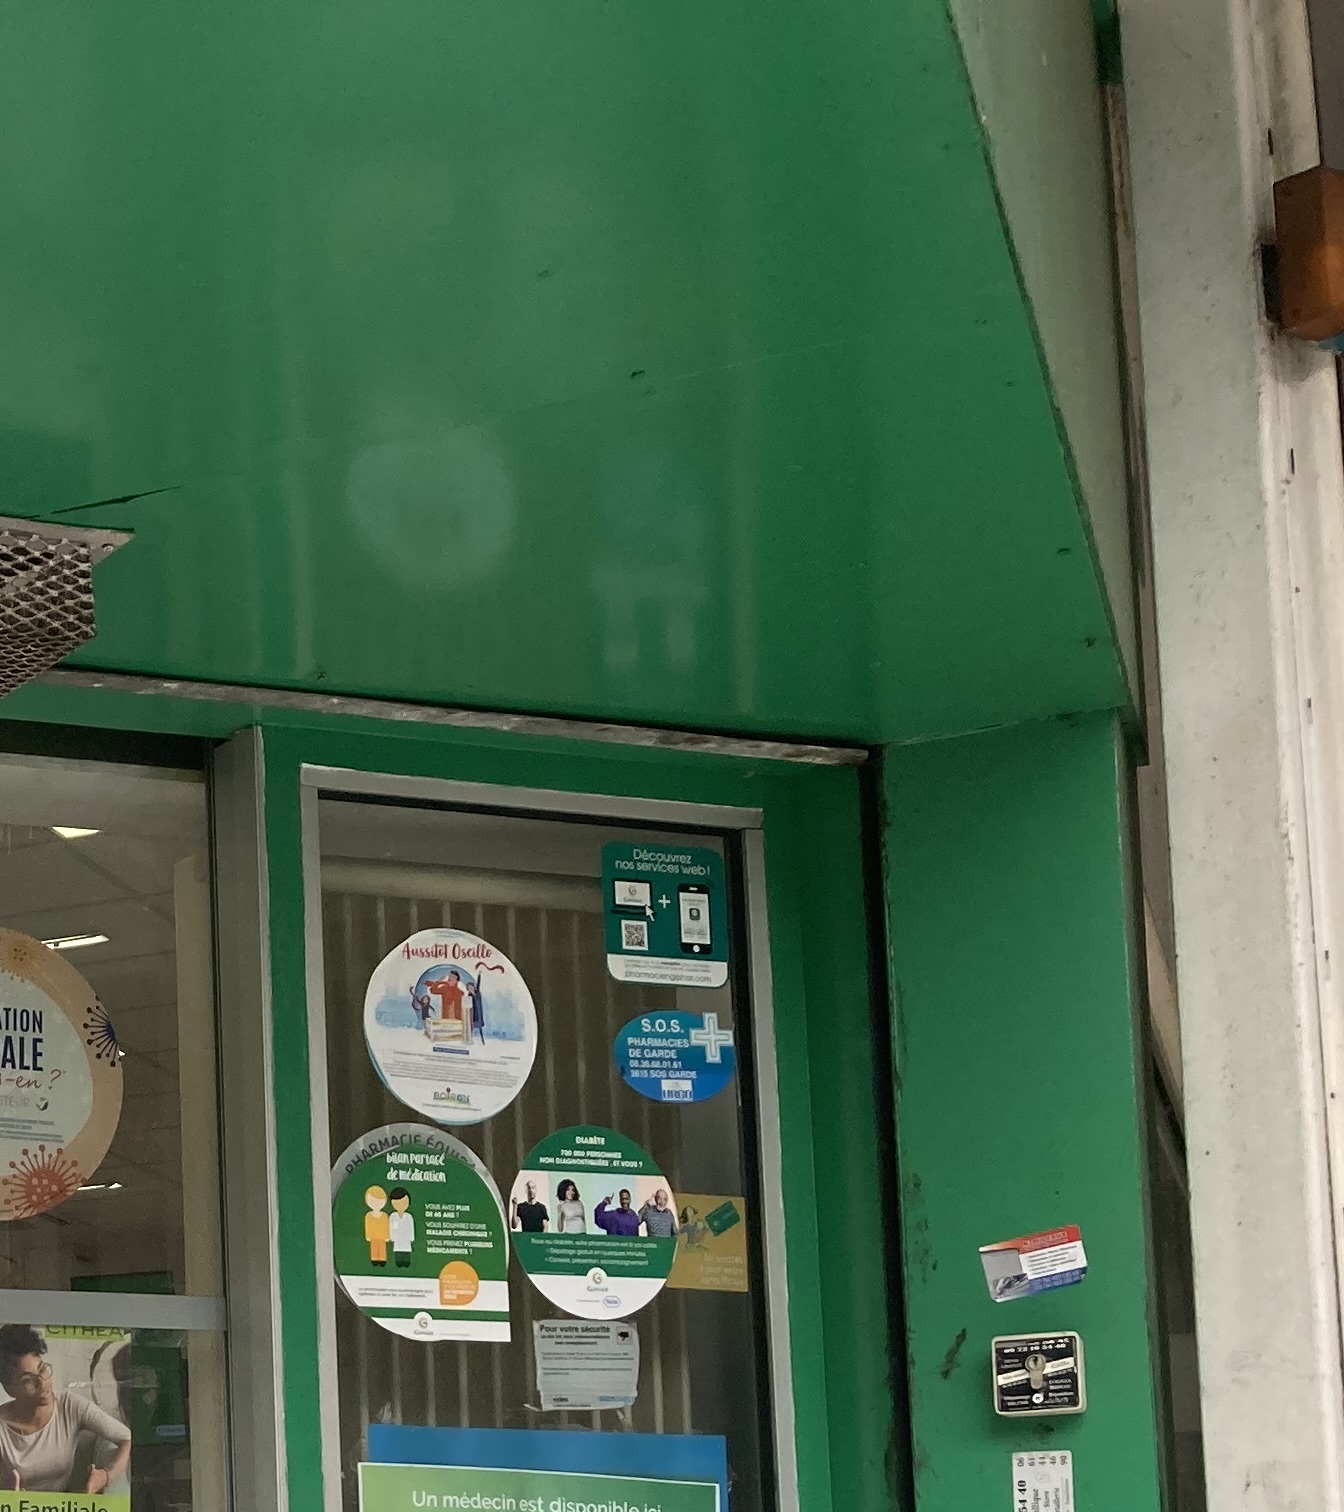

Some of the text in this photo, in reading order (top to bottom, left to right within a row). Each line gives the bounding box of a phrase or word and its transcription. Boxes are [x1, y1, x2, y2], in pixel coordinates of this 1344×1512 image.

[633, 848, 692, 864] Découvrez
[452, 942, 492, 960] Oscillo
[641, 1019, 685, 1033] S.O.S.
[627, 1037, 690, 1049] PHARMACIES
[629, 1048, 678, 1059] DE GARDE
[1017, 1479, 1027, 1495] 40
[412, 1491, 438, 1509] Un
[442, 1492, 516, 1511] médecin
[519, 1496, 545, 1512] est
